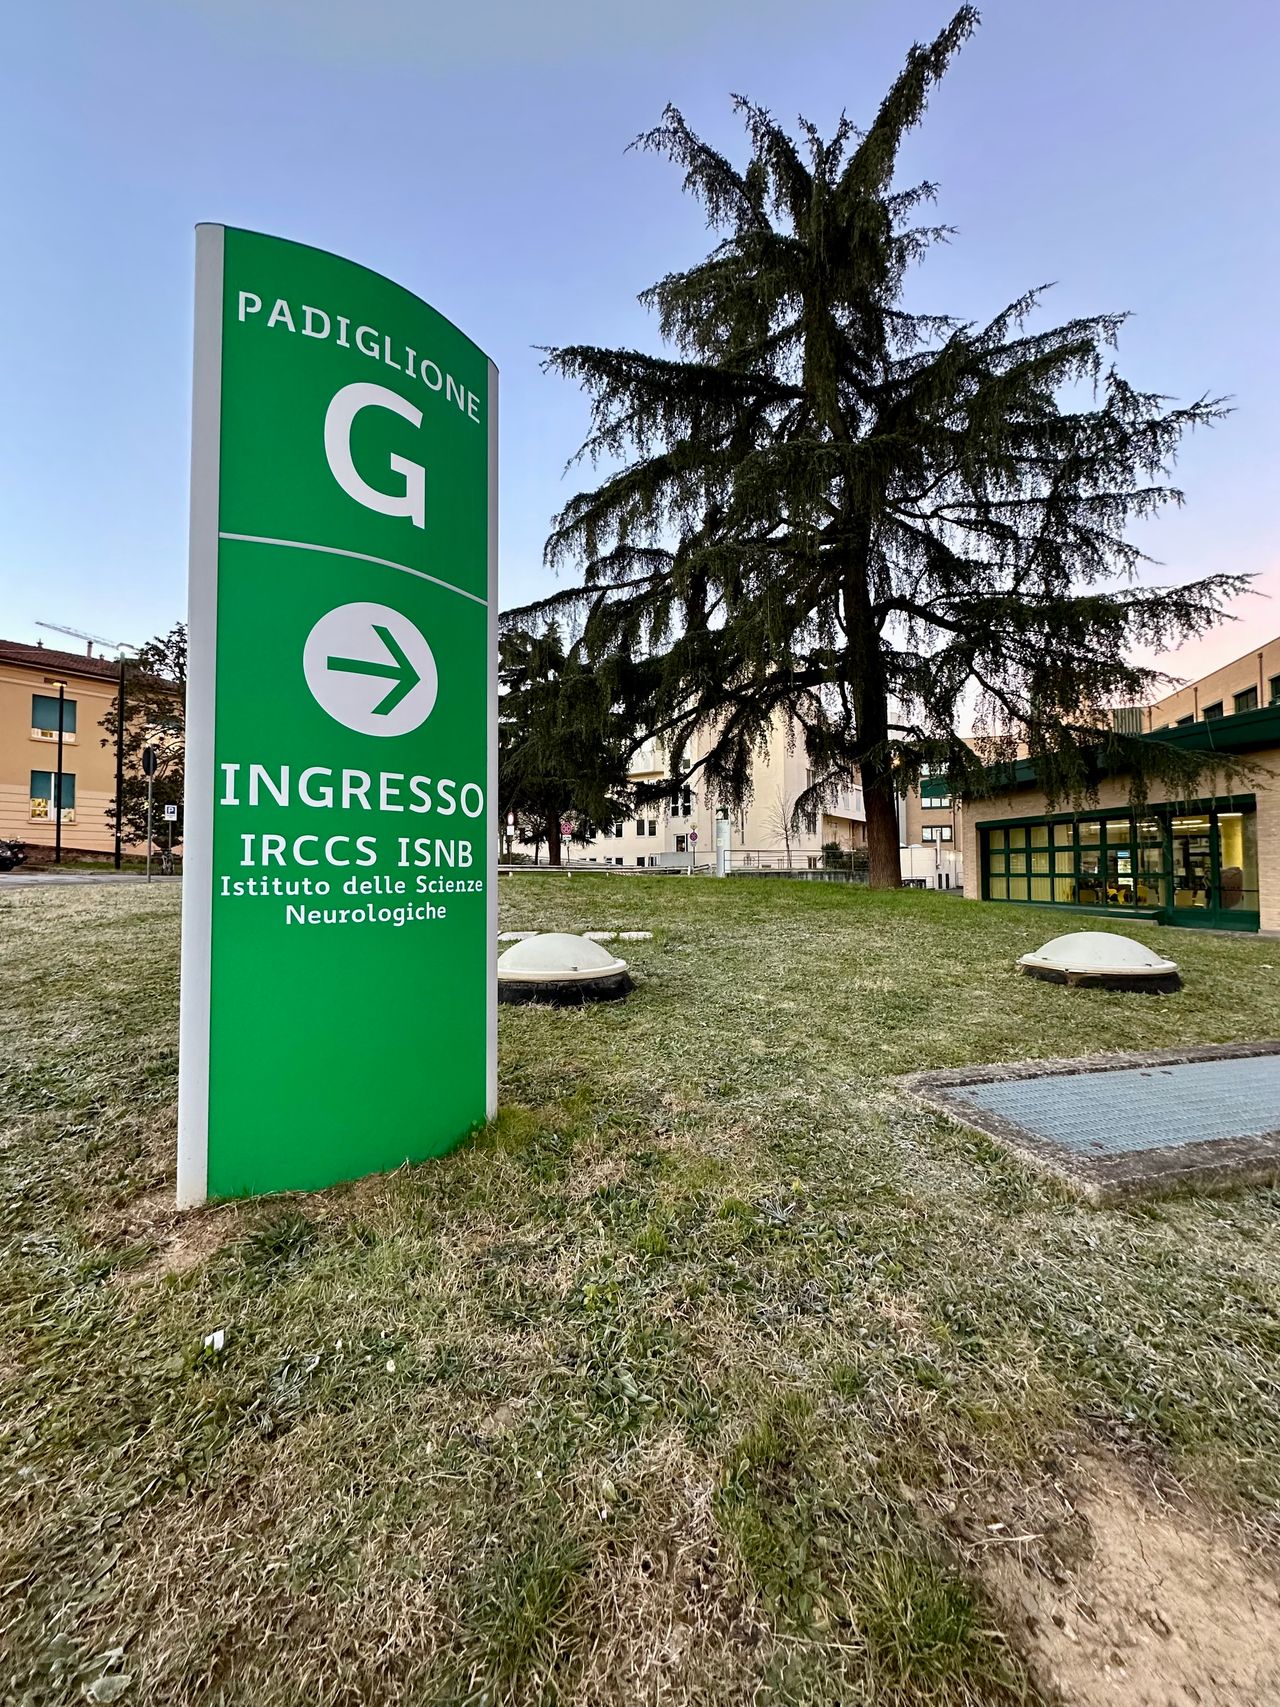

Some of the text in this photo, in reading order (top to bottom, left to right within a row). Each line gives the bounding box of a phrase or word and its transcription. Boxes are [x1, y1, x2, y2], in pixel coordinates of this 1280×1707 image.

[238, 290, 481, 424] PADIGLIONE
[323, 382, 426, 530] G
[220, 763, 485, 818] INGRESSO
[240, 833, 473, 868] IRCCS ISNB
[221, 875, 483, 896] Istituto delle Scienze
[286, 902, 447, 927] Neurologiche
